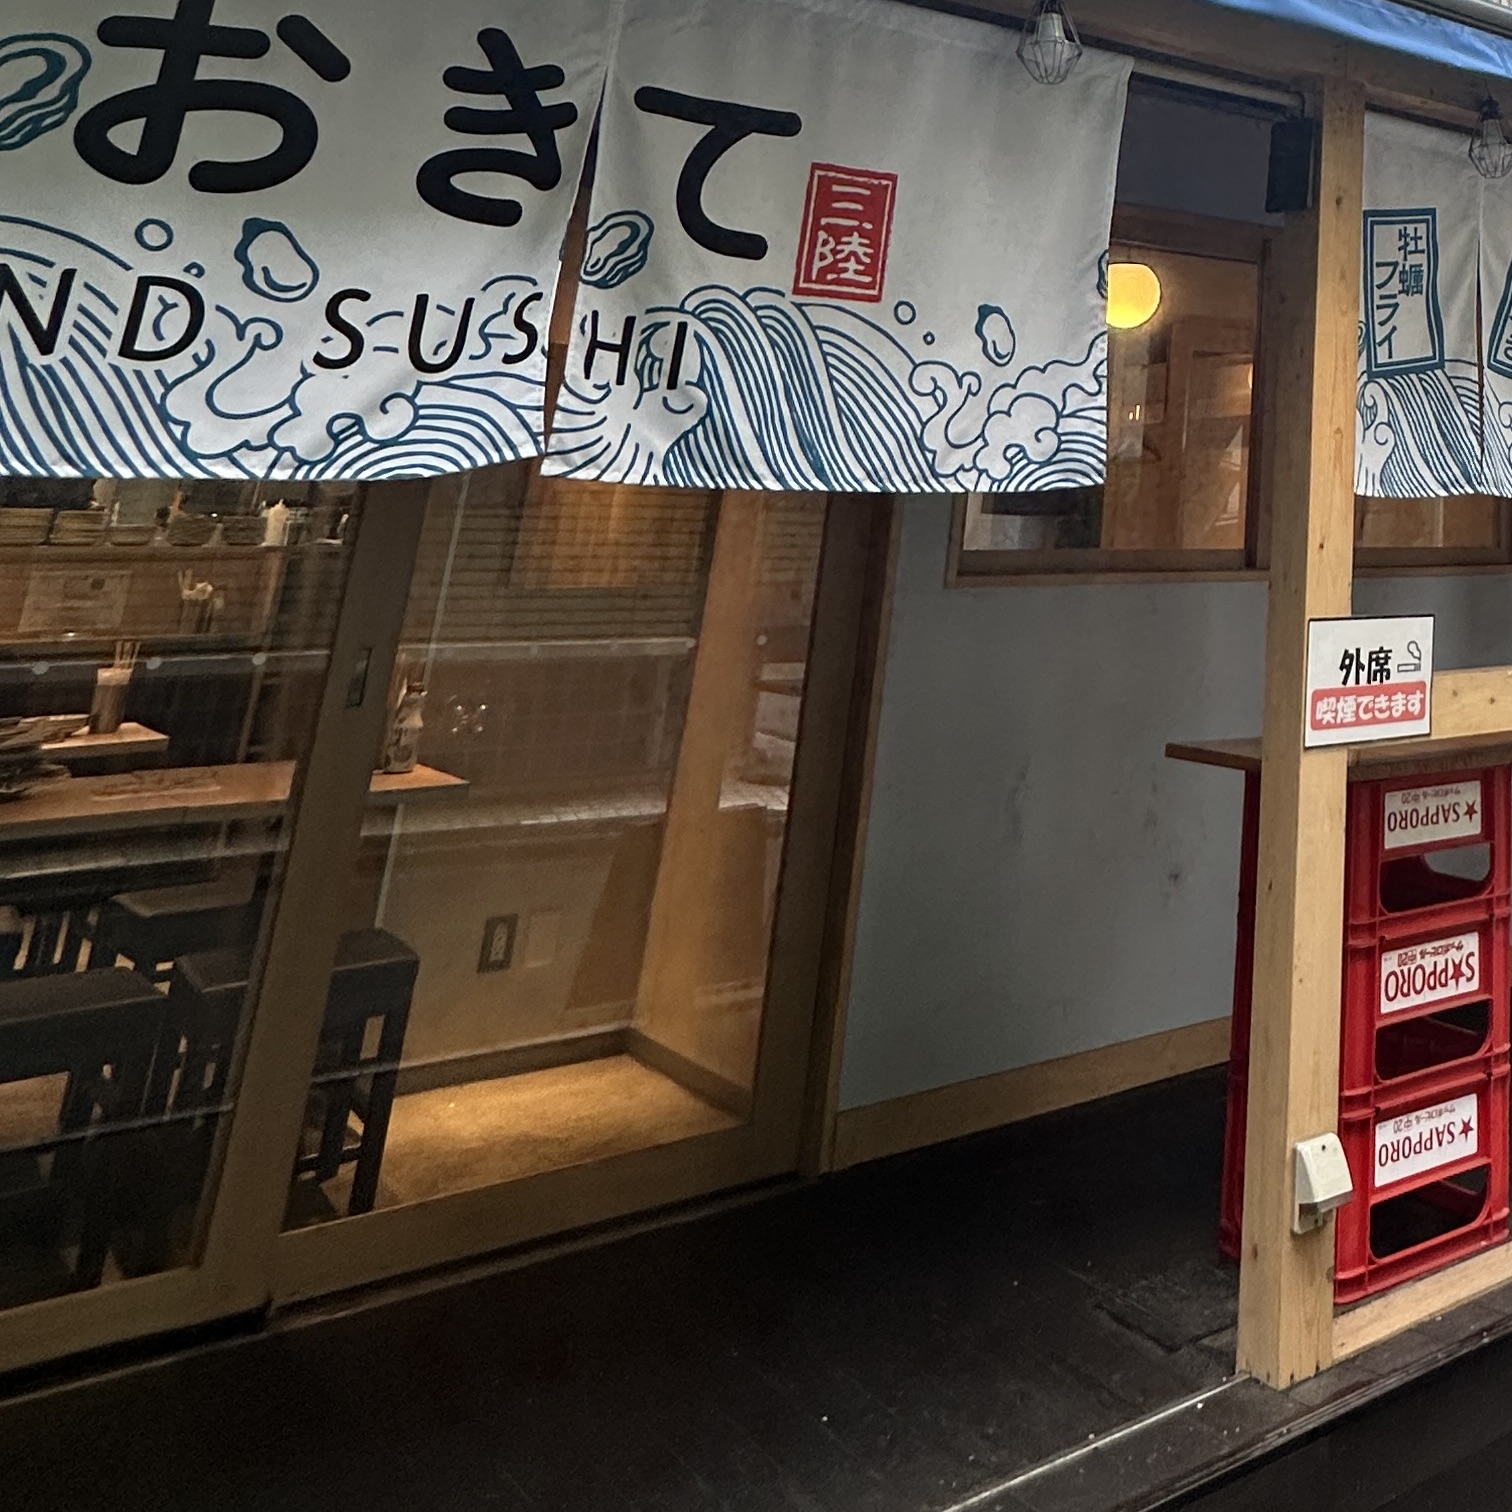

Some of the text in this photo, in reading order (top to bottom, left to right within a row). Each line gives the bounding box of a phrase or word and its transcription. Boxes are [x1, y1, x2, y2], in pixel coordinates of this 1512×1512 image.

[811, 184, 876, 283] 三陸
[1375, 259, 1400, 360] フライ
[312, 288, 688, 391] SUSHI
[1339, 646, 1393, 686] 外席
[1315, 690, 1425, 725] 喫煙できます
[1387, 801, 1461, 832] SAPPORO
[1378, 1121, 1456, 1167] SAPPORO
